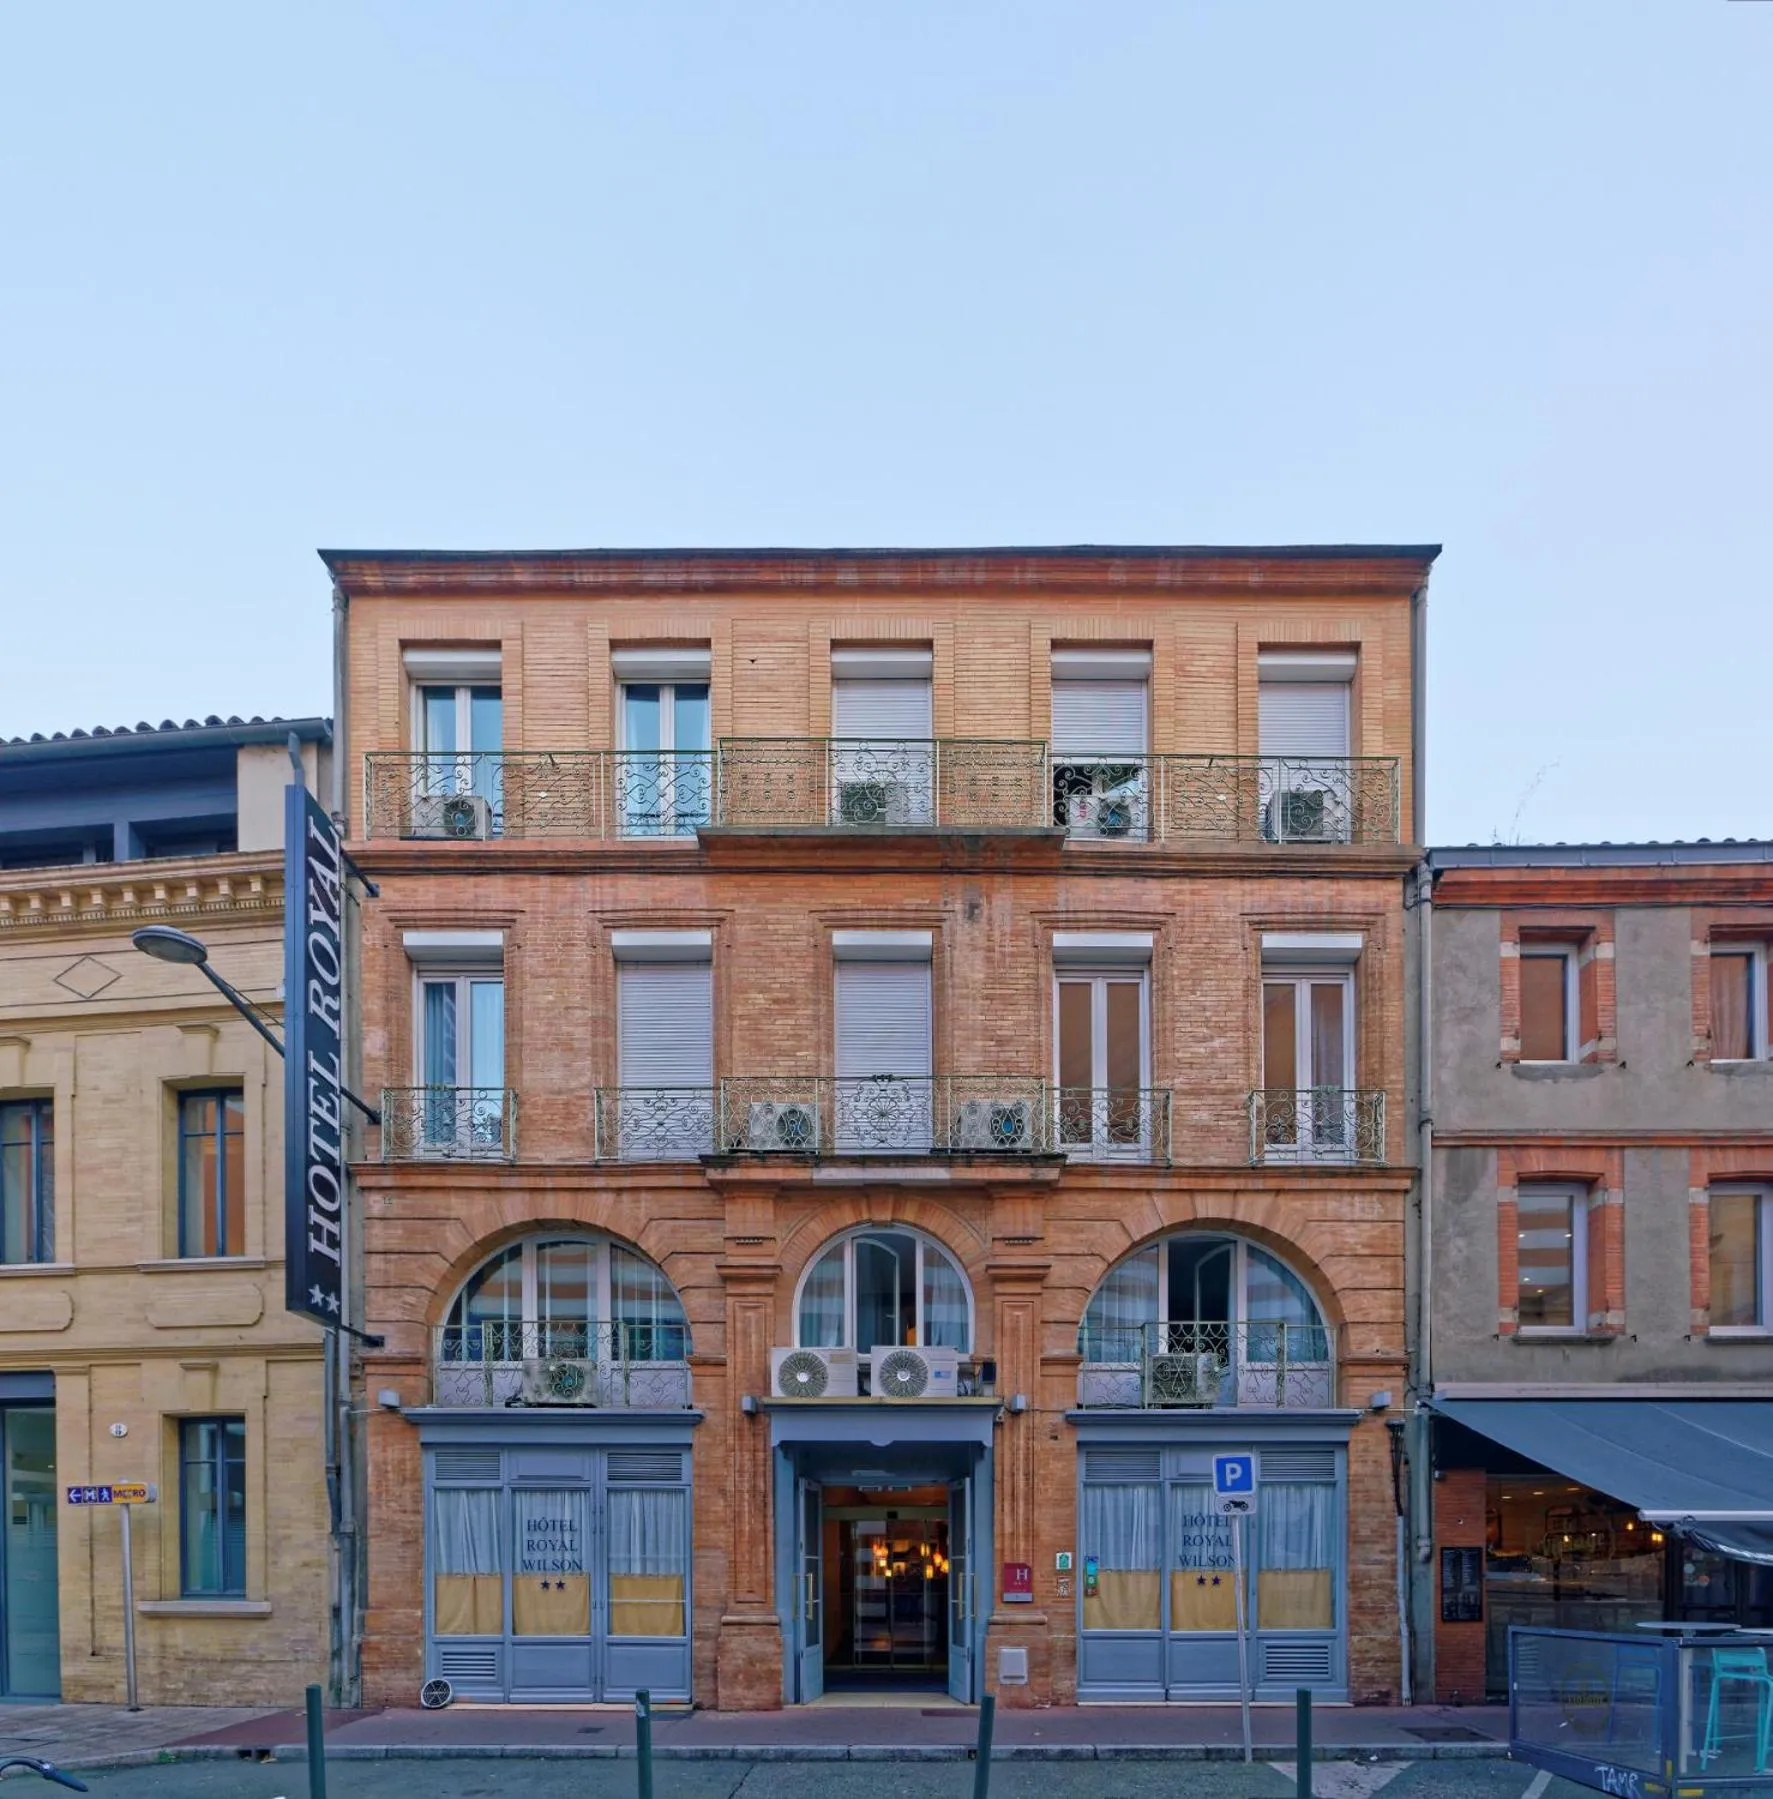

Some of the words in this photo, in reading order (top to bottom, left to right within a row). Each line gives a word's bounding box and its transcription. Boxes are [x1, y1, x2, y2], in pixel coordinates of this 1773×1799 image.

[308, 815, 341, 1040] ROYAL
[308, 1050, 341, 1267] HOTEL
[1225, 1463, 1243, 1487] P
[527, 1539, 578, 1552] ROYAL
[1183, 1534, 1233, 1547] ROYAL
[522, 1559, 583, 1572] WILSON
[1016, 1568, 1028, 1581] H
